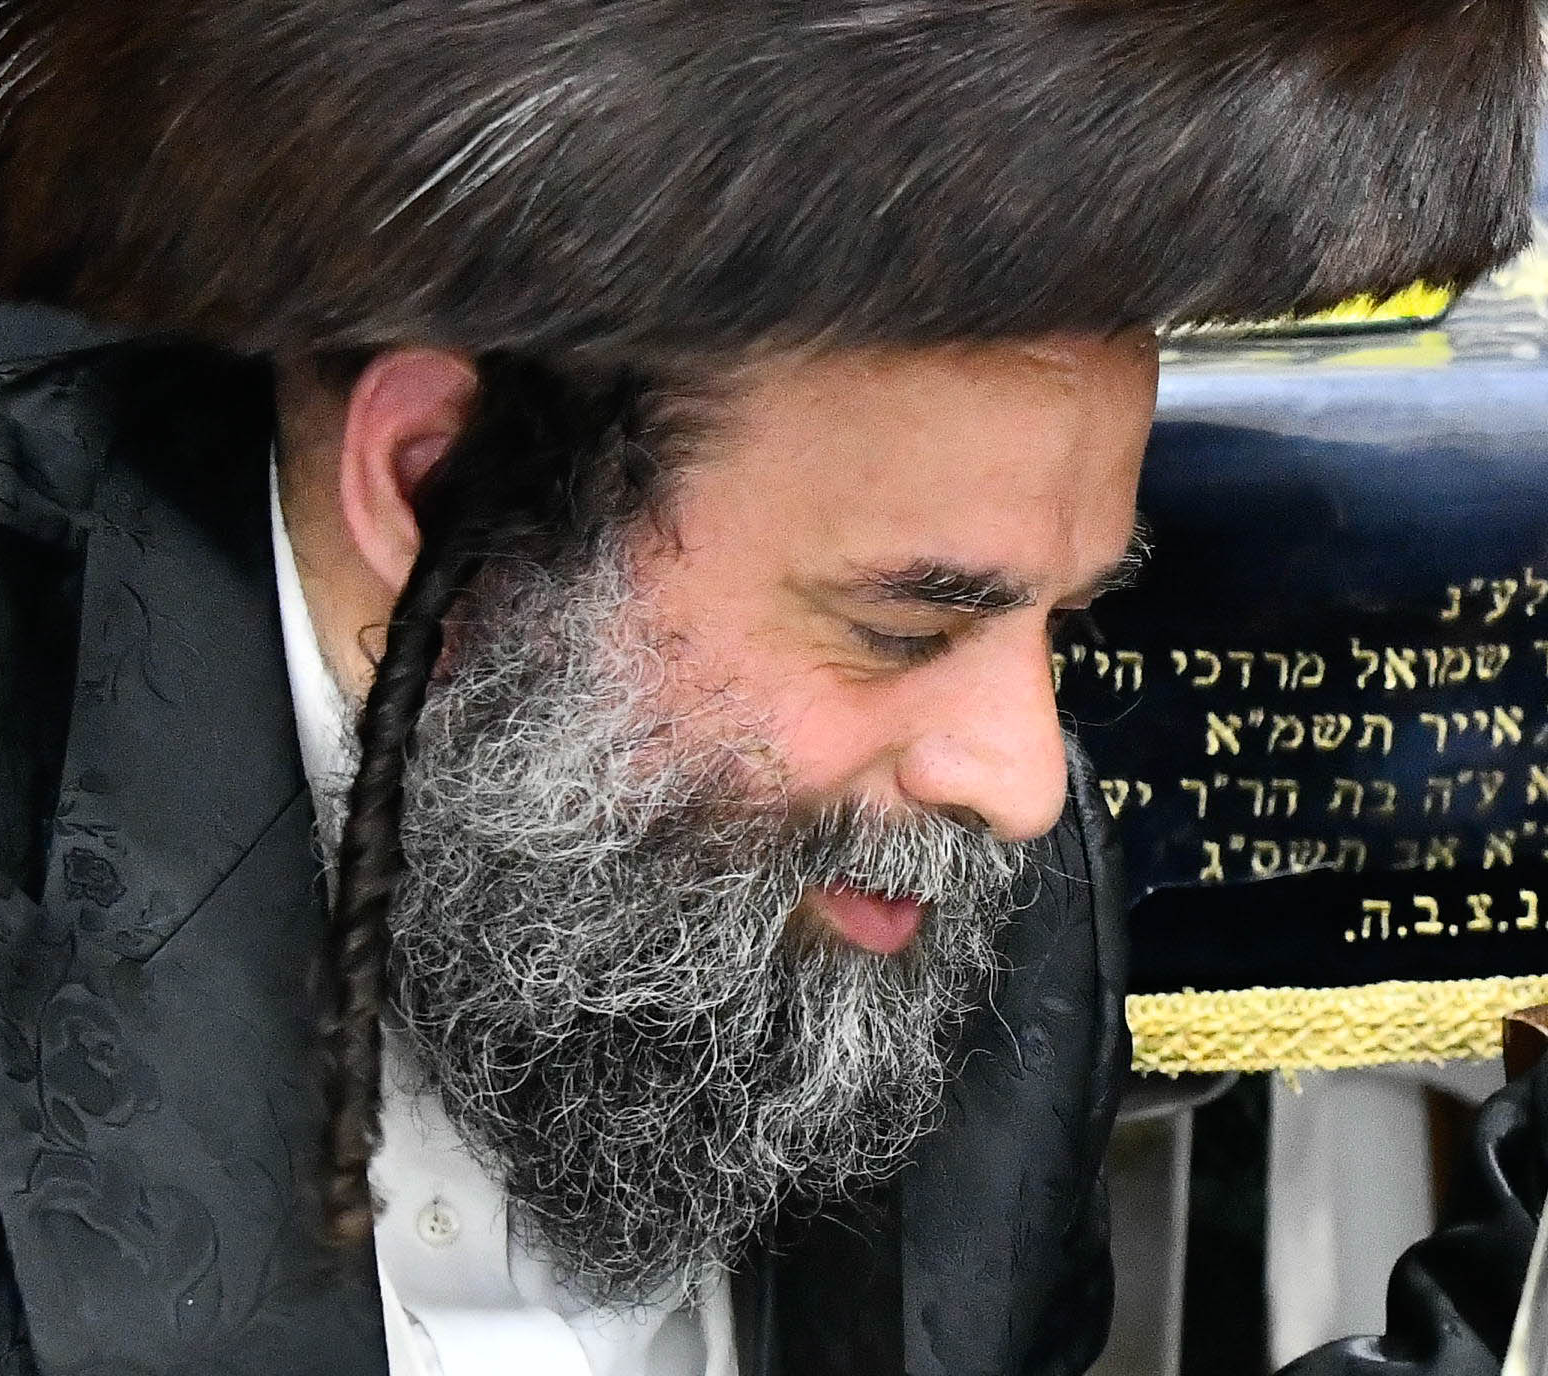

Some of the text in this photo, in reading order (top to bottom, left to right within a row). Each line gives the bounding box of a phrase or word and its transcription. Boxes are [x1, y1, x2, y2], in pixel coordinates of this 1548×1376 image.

[1170, 650, 1326, 690] מרדכי
[1351, 637, 1510, 690] שמואל
[1419, 705, 1523, 754] אייר
[1328, 778, 1398, 818] בת
